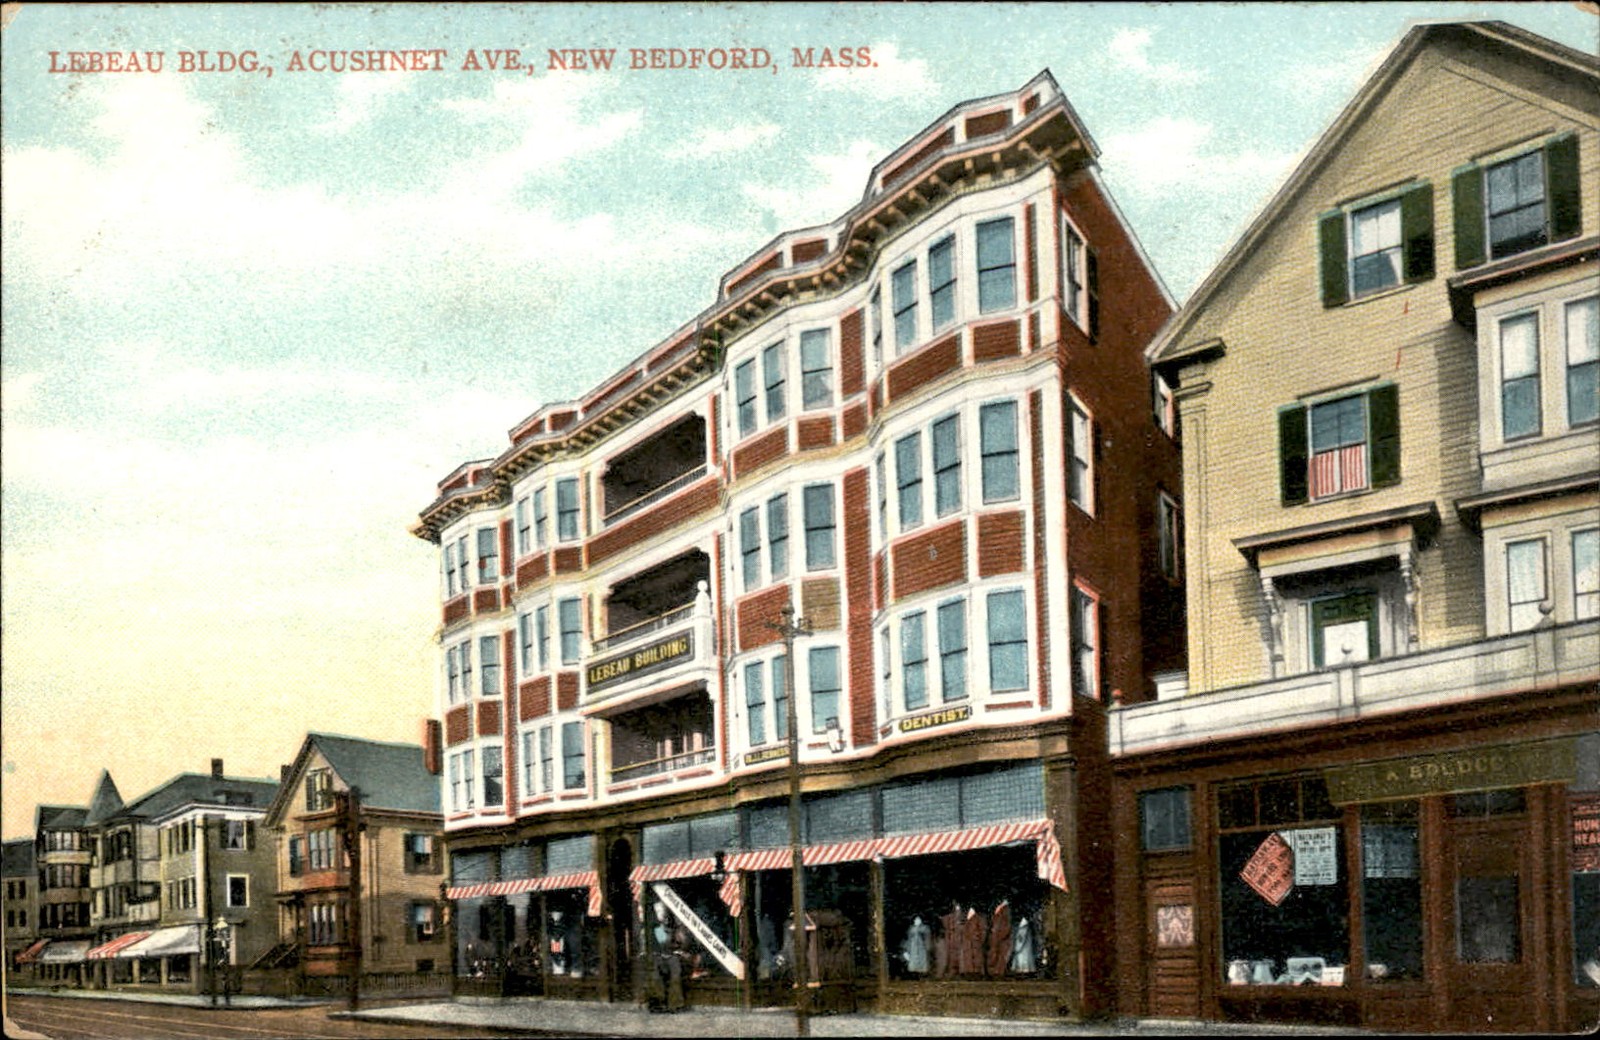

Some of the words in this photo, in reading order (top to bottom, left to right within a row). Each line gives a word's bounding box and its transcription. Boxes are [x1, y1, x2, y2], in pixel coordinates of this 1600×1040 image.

[590, 656, 631, 683] LEBEAU
[634, 637, 688, 669] BUILDING
[902, 708, 968, 731] DENTIST.
